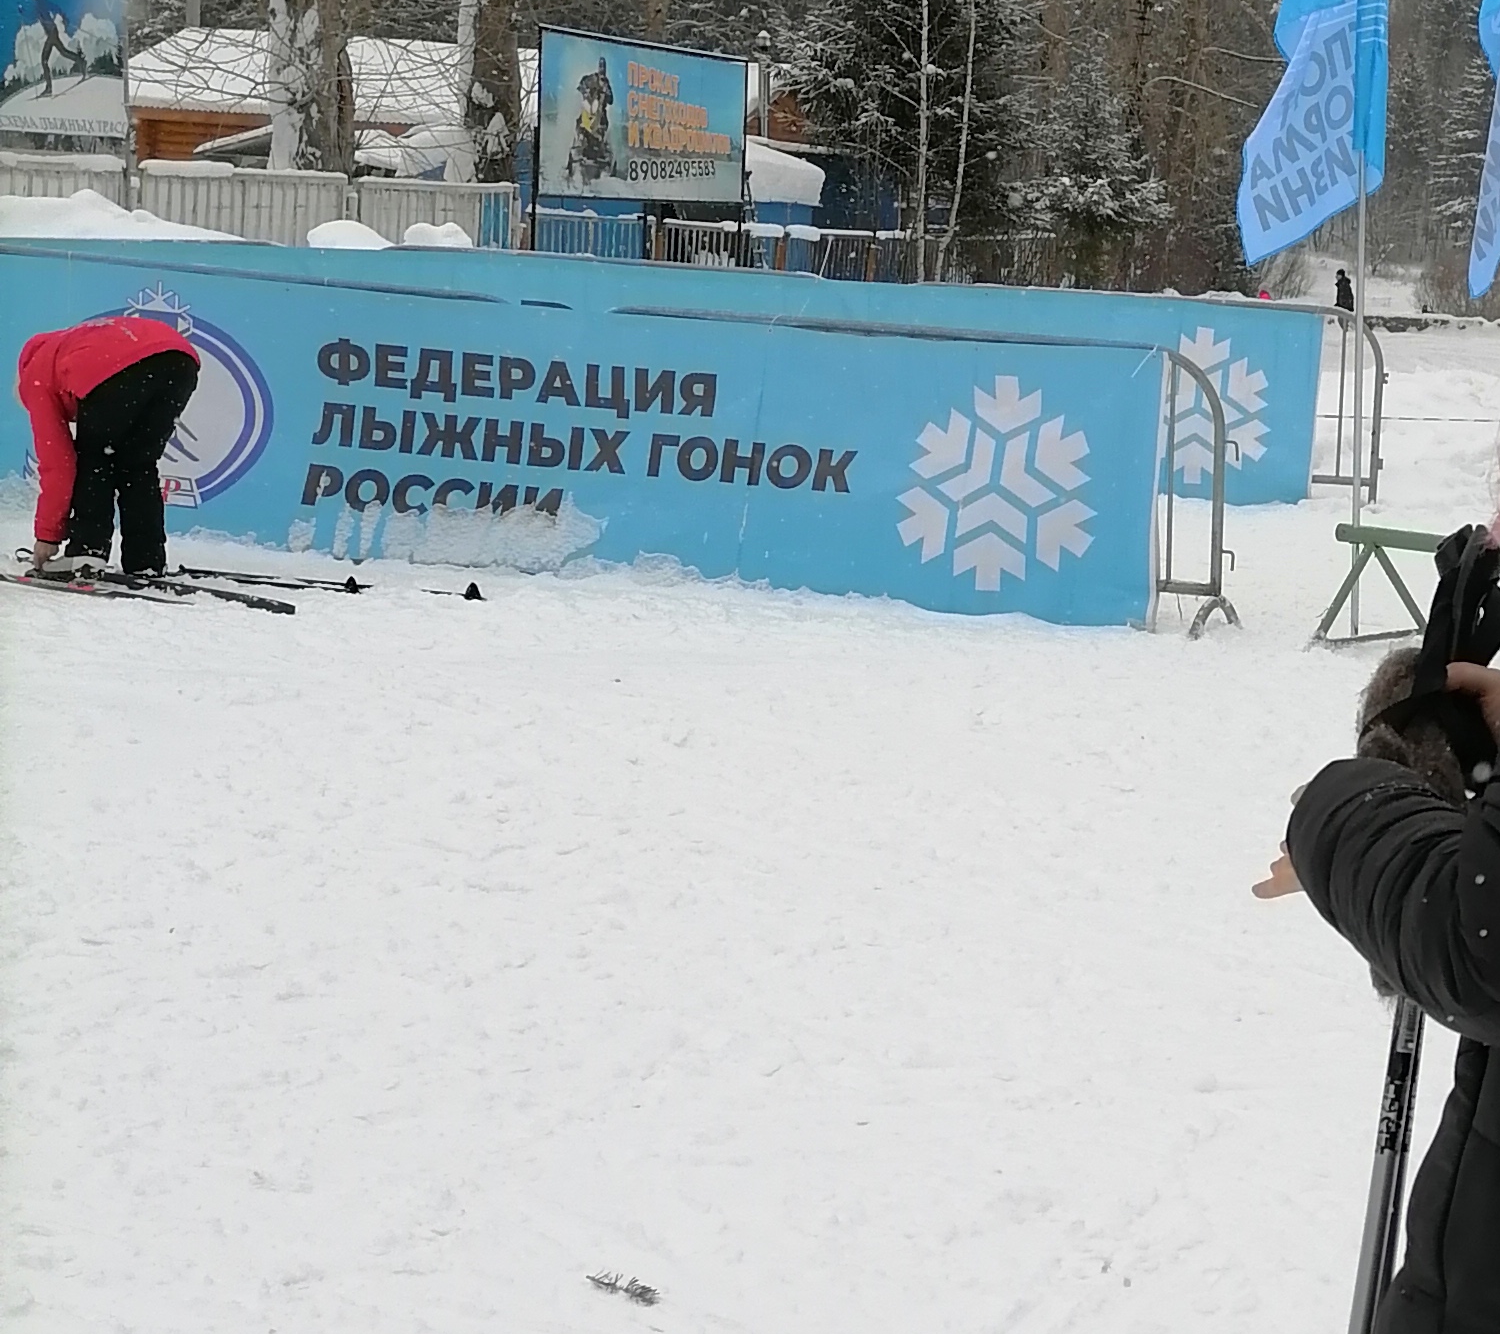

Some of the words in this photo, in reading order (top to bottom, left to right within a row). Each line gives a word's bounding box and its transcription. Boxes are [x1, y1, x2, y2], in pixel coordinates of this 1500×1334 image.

[628, 62, 679, 97] ПРОКАТ
[40, 117, 95, 134] ЛЫЖНЫХ
[629, 160, 715, 181] 89082495583
[315, 337, 718, 419] ФЕДЕРАЦИЯ
[312, 401, 632, 475] ЛЫЖНЫХ
[646, 433, 858, 494] ГОНОК
